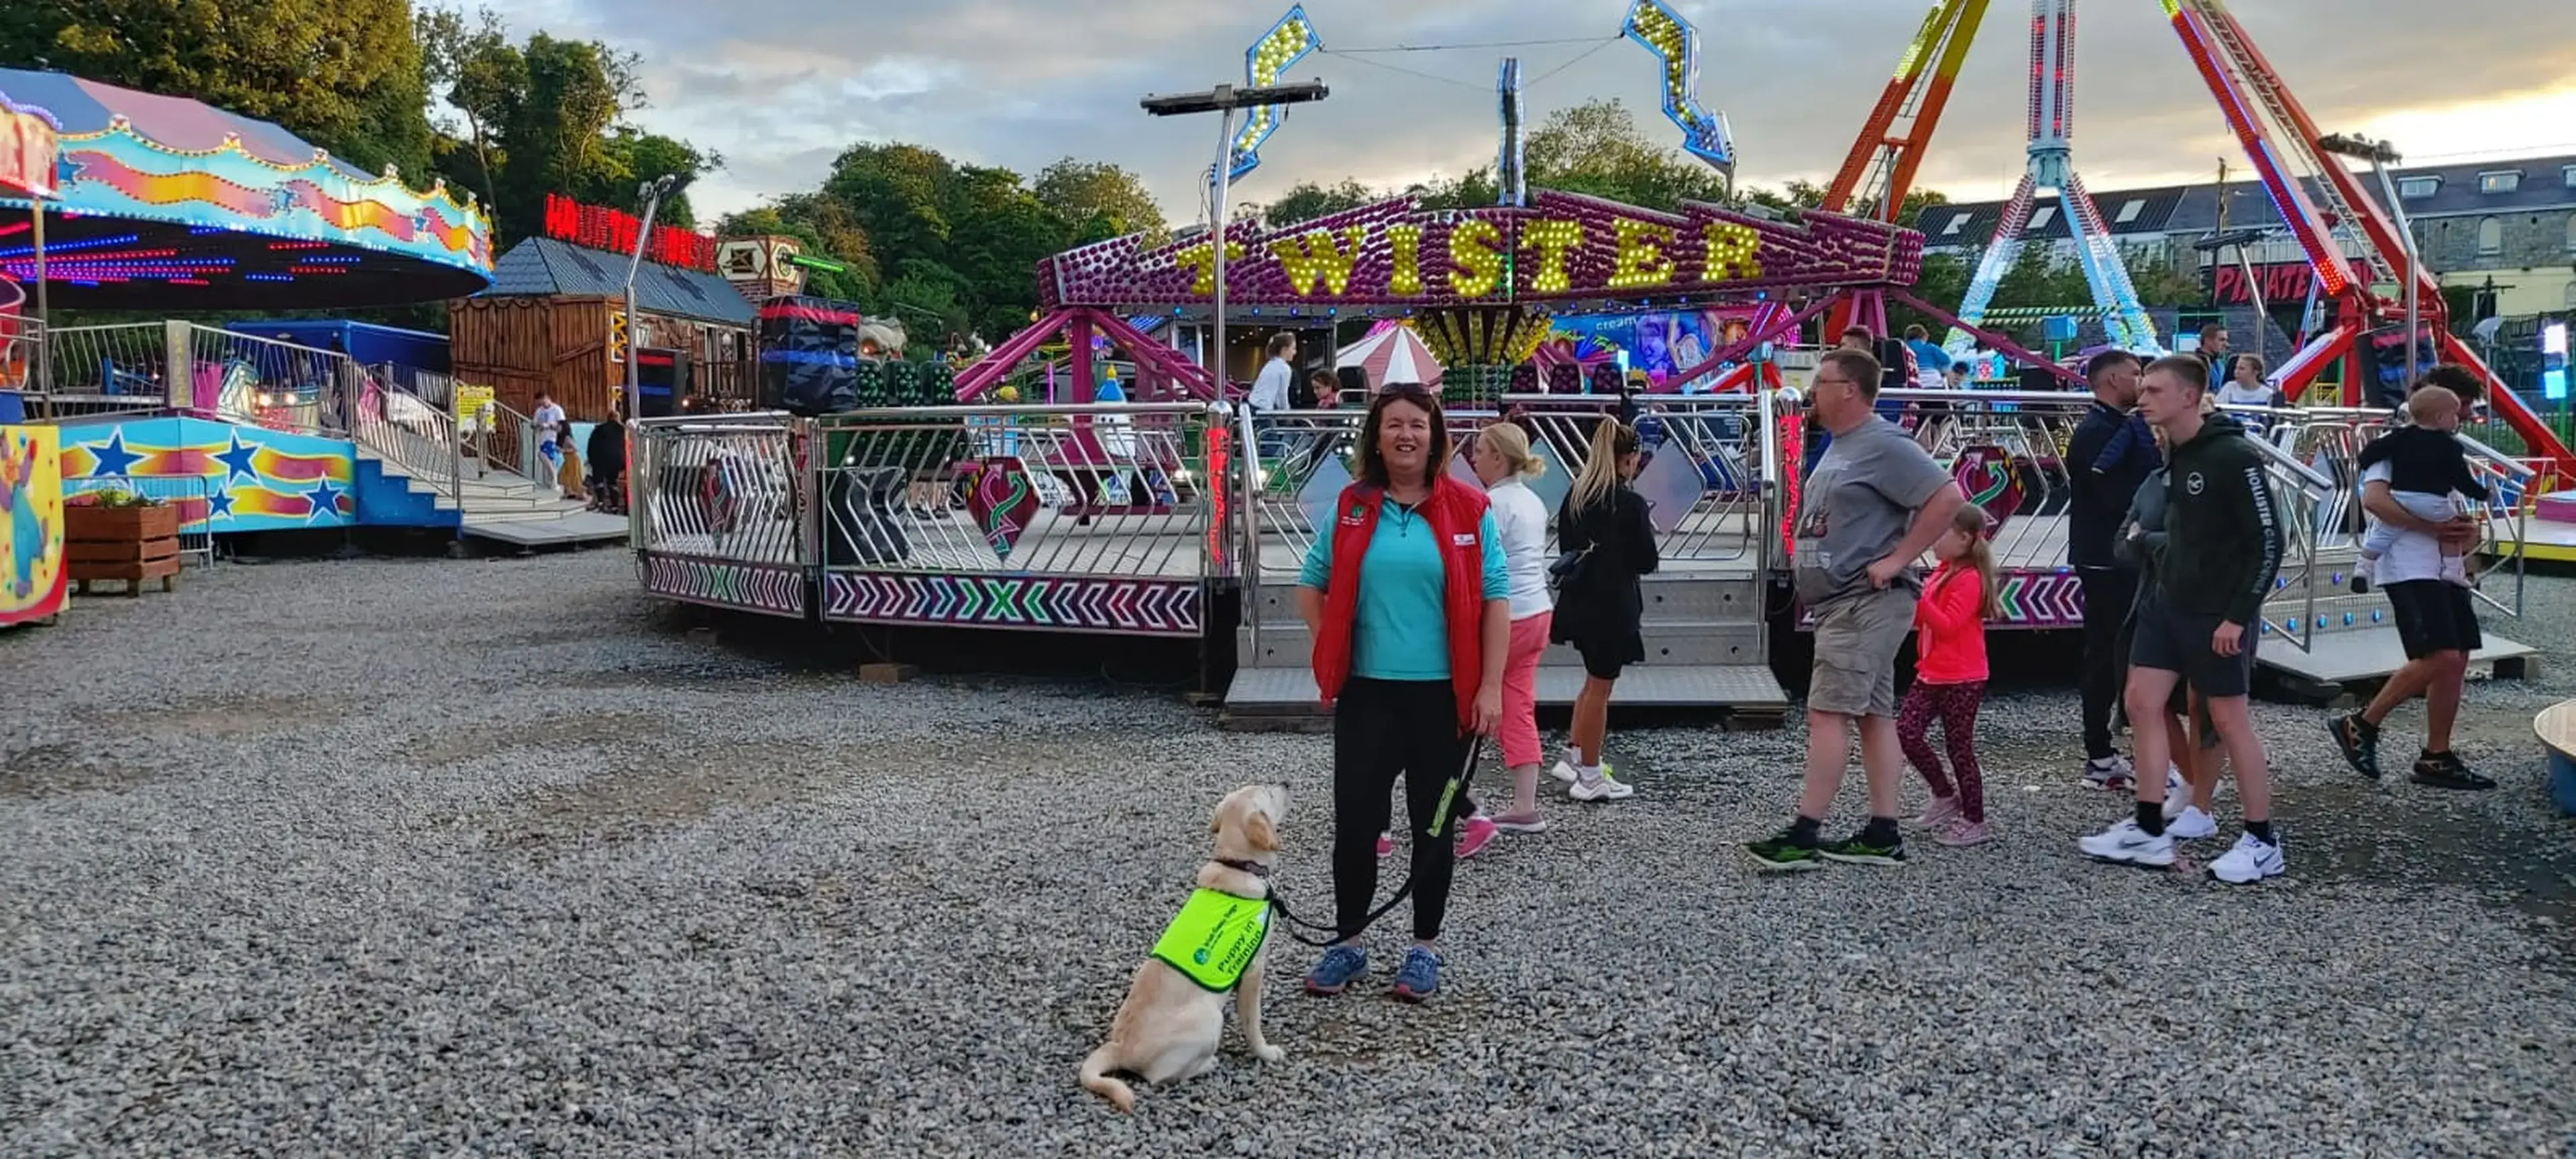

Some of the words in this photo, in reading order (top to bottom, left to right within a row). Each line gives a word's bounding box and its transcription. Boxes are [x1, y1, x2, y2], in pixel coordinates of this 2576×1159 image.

[545, 192, 653, 259] HAUNTE
[1175, 217, 1766, 298] TWISTER
[1596, 316, 1637, 331] cream
[2243, 467, 2273, 526] HOLLISTER
[1218, 934, 1246, 973] Puppy
[1245, 920, 1255, 933] in
